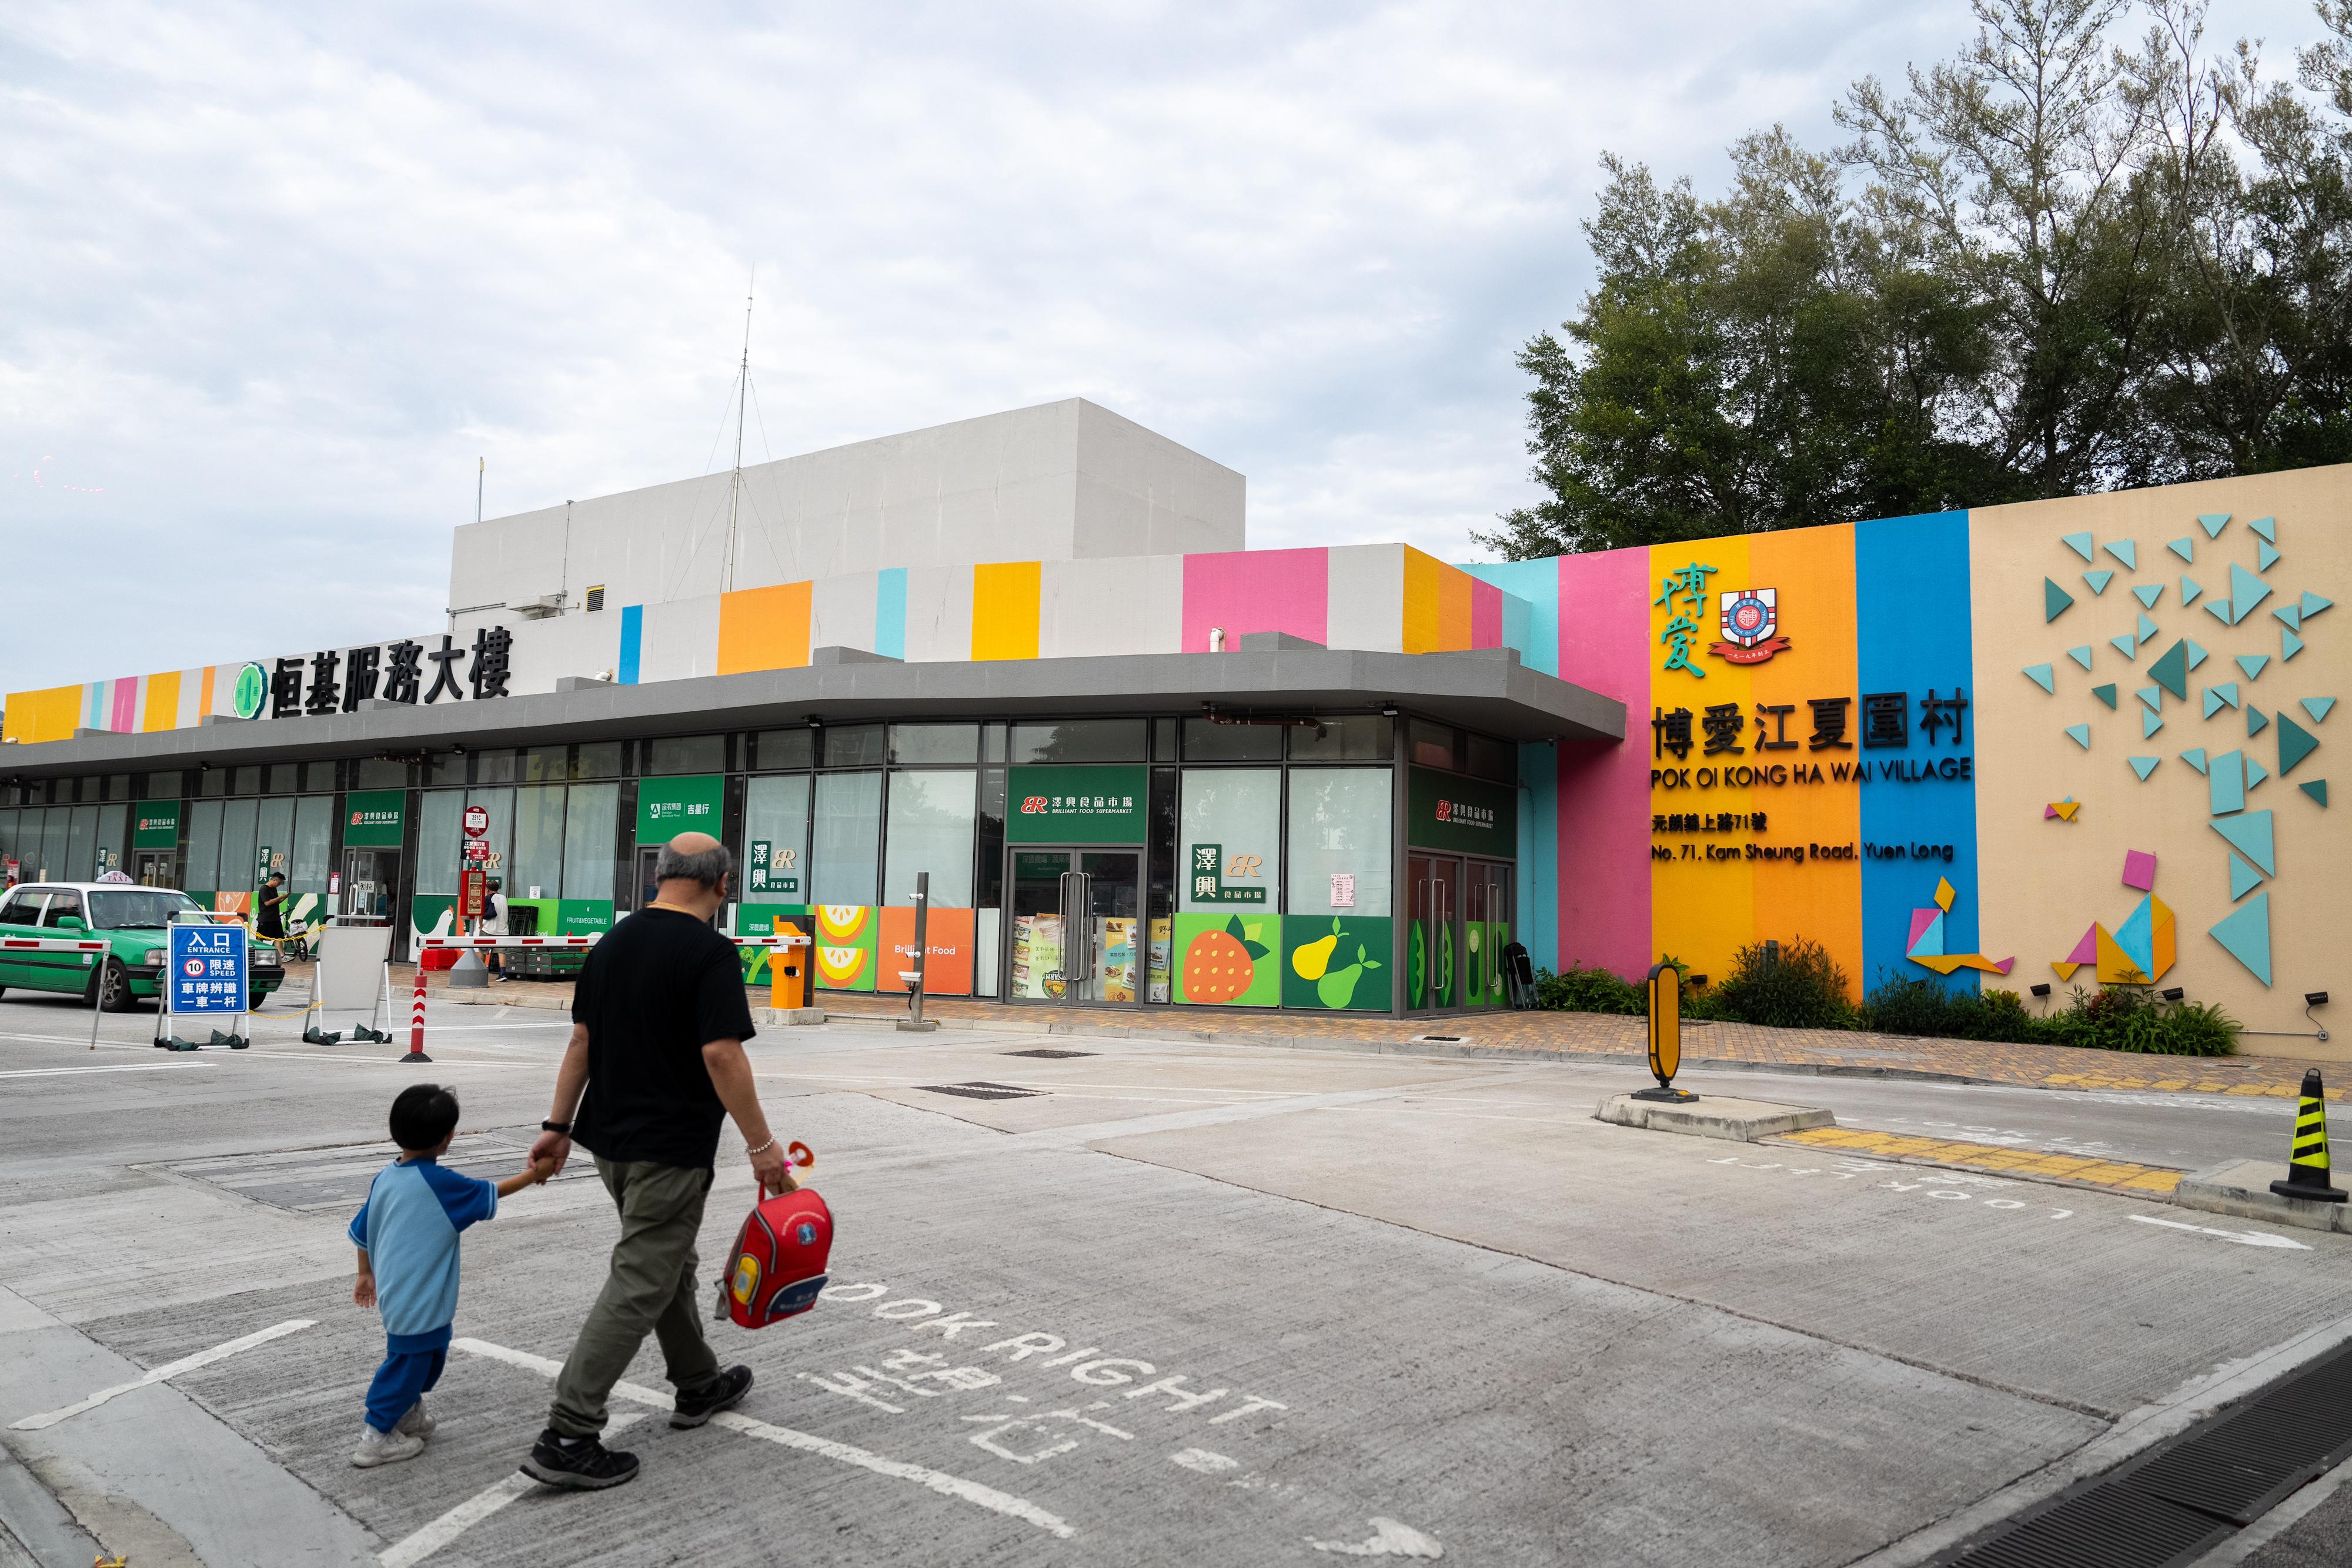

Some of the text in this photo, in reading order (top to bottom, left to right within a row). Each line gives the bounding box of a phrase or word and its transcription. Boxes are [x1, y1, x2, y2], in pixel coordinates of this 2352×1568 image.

[1733, 626, 1743, 634] POK
[1754, 610, 1766, 633] HOSPITAL
[270, 626, 513, 719] 恒基服務大樓
[1651, 687, 1968, 760] 博愛江夏圍村
[1651, 757, 1972, 789] POK OI KONG HA WAI VILLAGE
[687, 803, 710, 815] 吉星行
[1052, 797, 1132, 807] 澤興食品市場
[1475, 821, 1494, 829] SUPERMARKET
[1651, 811, 1768, 832] 元朗錦上路71號
[1651, 844, 1677, 860] No.
[1706, 844, 1741, 860] Kam
[1745, 843, 1805, 862] Sheung
[1863, 842, 1906, 858] Yuen
[1911, 841, 1954, 862] Long
[752, 844, 767, 888] 澤興
[1195, 848, 1217, 898] 澤興
[566, 917, 607, 925] FRUIT&VEGETABLE
[188, 931, 229, 947] 入口
[894, 945, 956, 955] Brillit Food
[188, 963, 201, 972] 10
[209, 959, 235, 970] 限速
[181, 982, 237, 994] 車牌辨識
[181, 996, 237, 1008] 一車一杆
[1886, 1118, 2039, 1137] LOOK
[1706, 1157, 2074, 1219] LOOK LEFT
[818, 1282, 1289, 1426] OOK RIGHT
